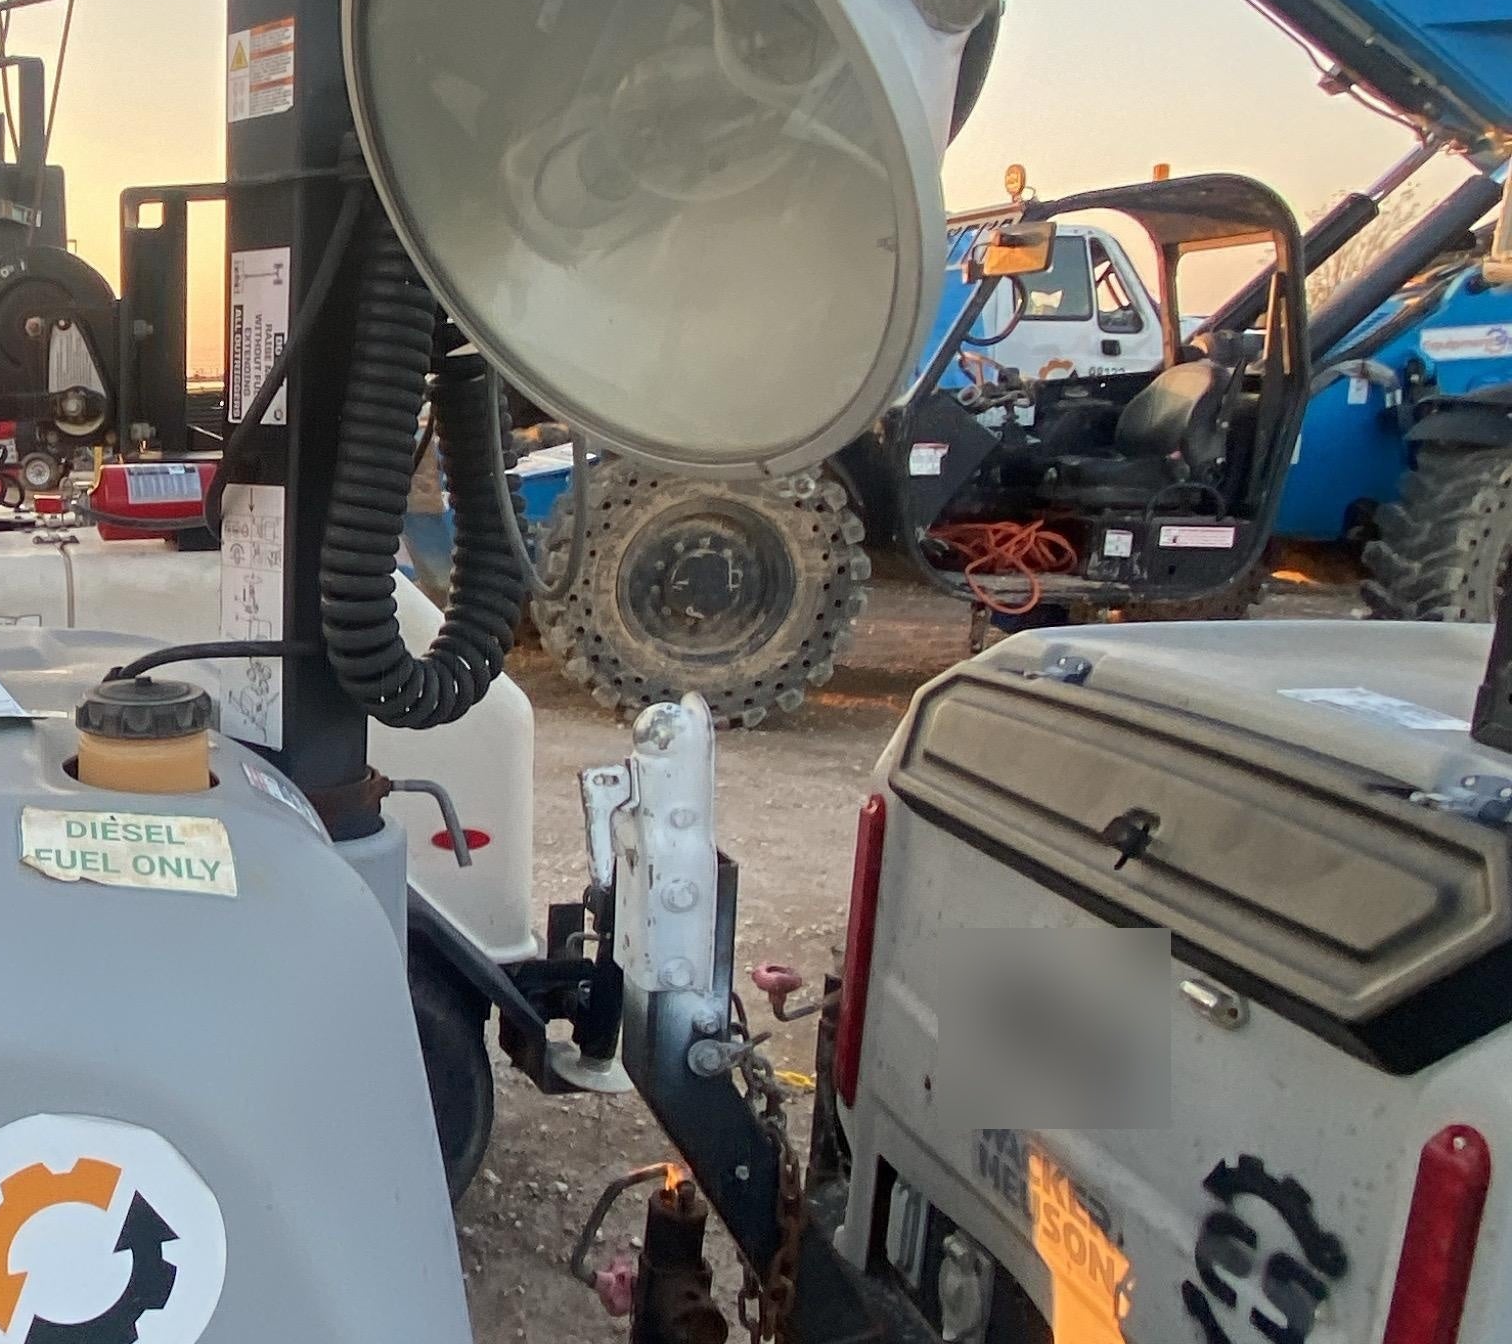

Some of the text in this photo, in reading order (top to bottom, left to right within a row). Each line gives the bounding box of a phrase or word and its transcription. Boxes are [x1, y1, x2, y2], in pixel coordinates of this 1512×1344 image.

[65, 819, 186, 846] DIESEL
[34, 848, 221, 882] FUEL ONLY
